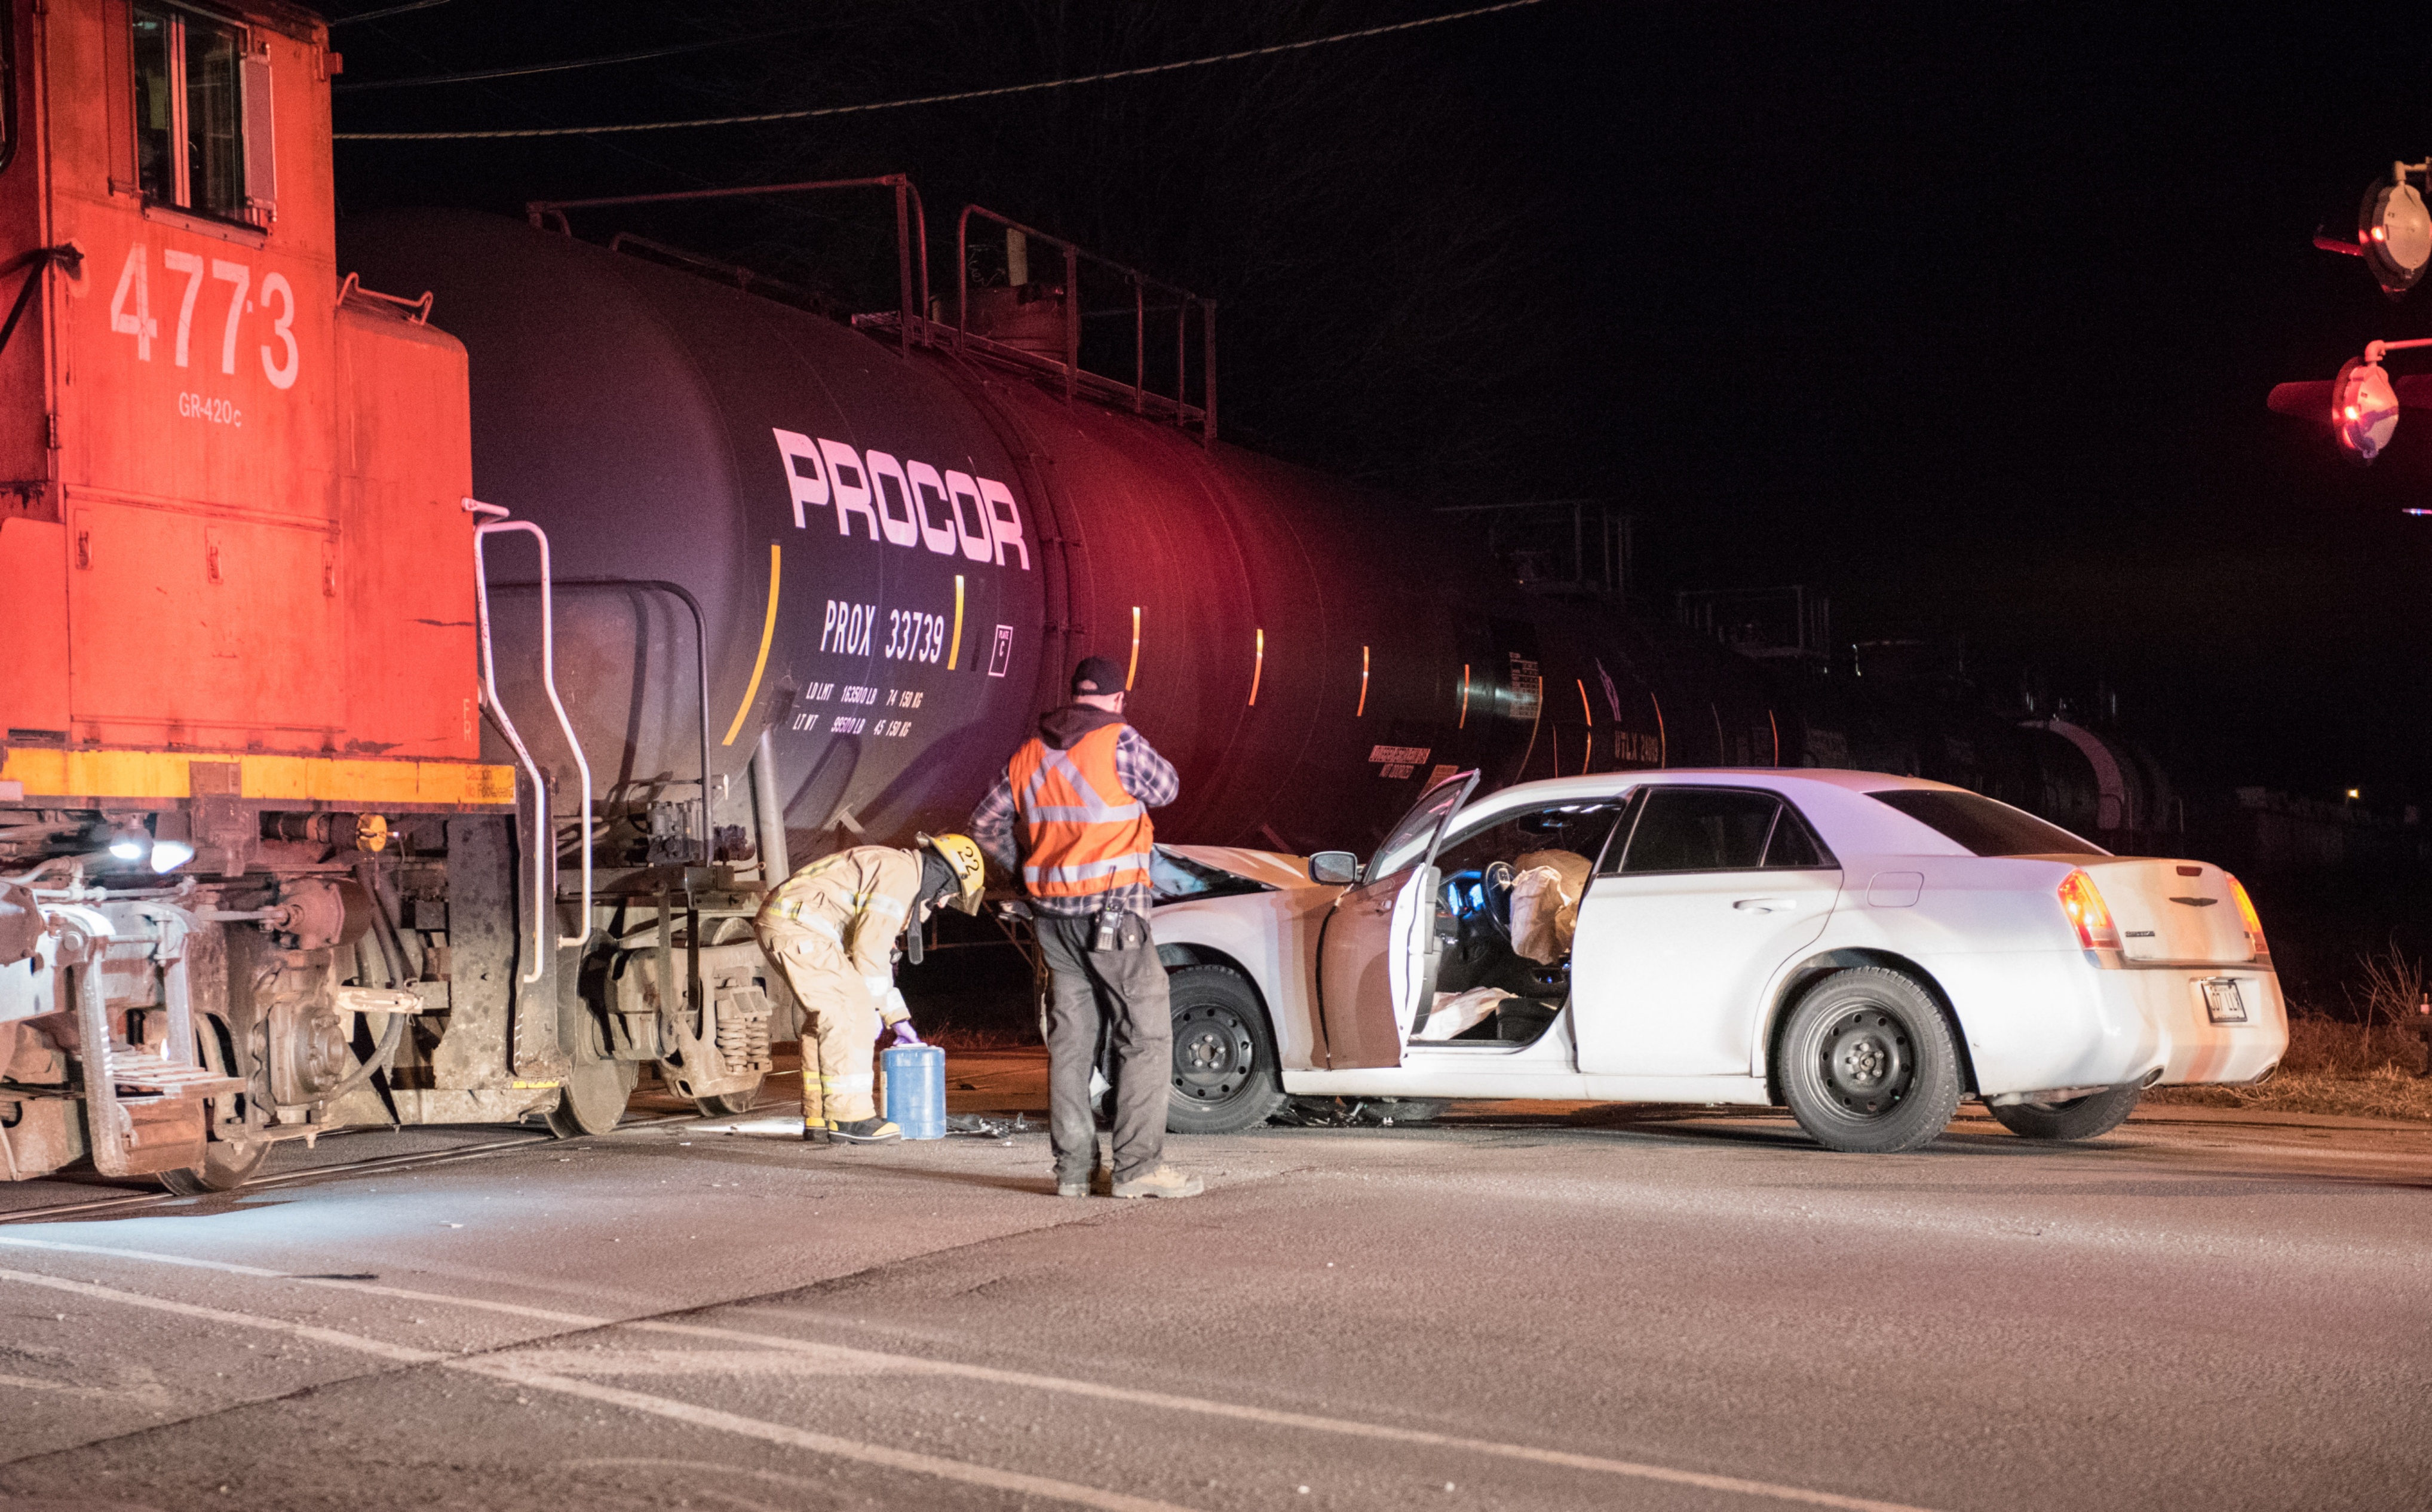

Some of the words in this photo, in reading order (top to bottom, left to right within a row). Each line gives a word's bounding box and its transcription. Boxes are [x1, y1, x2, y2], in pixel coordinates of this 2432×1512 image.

[110, 240, 299, 389] 4773
[772, 427, 1031, 571] PROCOR
[820, 599, 876, 657] PROX
[885, 608, 944, 664] 33739
[998, 630, 1010, 640] PLATE
[999, 640, 1005, 657] C
[806, 682, 818, 700] LD
[816, 682, 835, 701] LMT
[841, 685, 869, 704] 163500
[866, 688, 878, 705] LB
[886, 689, 898, 706] 74
[899, 691, 913, 708] 150
[911, 692, 924, 709] KG
[792, 713, 806, 730] LT
[803, 714, 819, 731] WT
[831, 716, 857, 734] 99500
[852, 717, 866, 734] LB
[873, 719, 887, 735] 45
[885, 720, 902, 737] 150
[898, 722, 912, 737] KG
[1615, 731, 1637, 760] UTLX
[957, 846, 980, 876] 22
